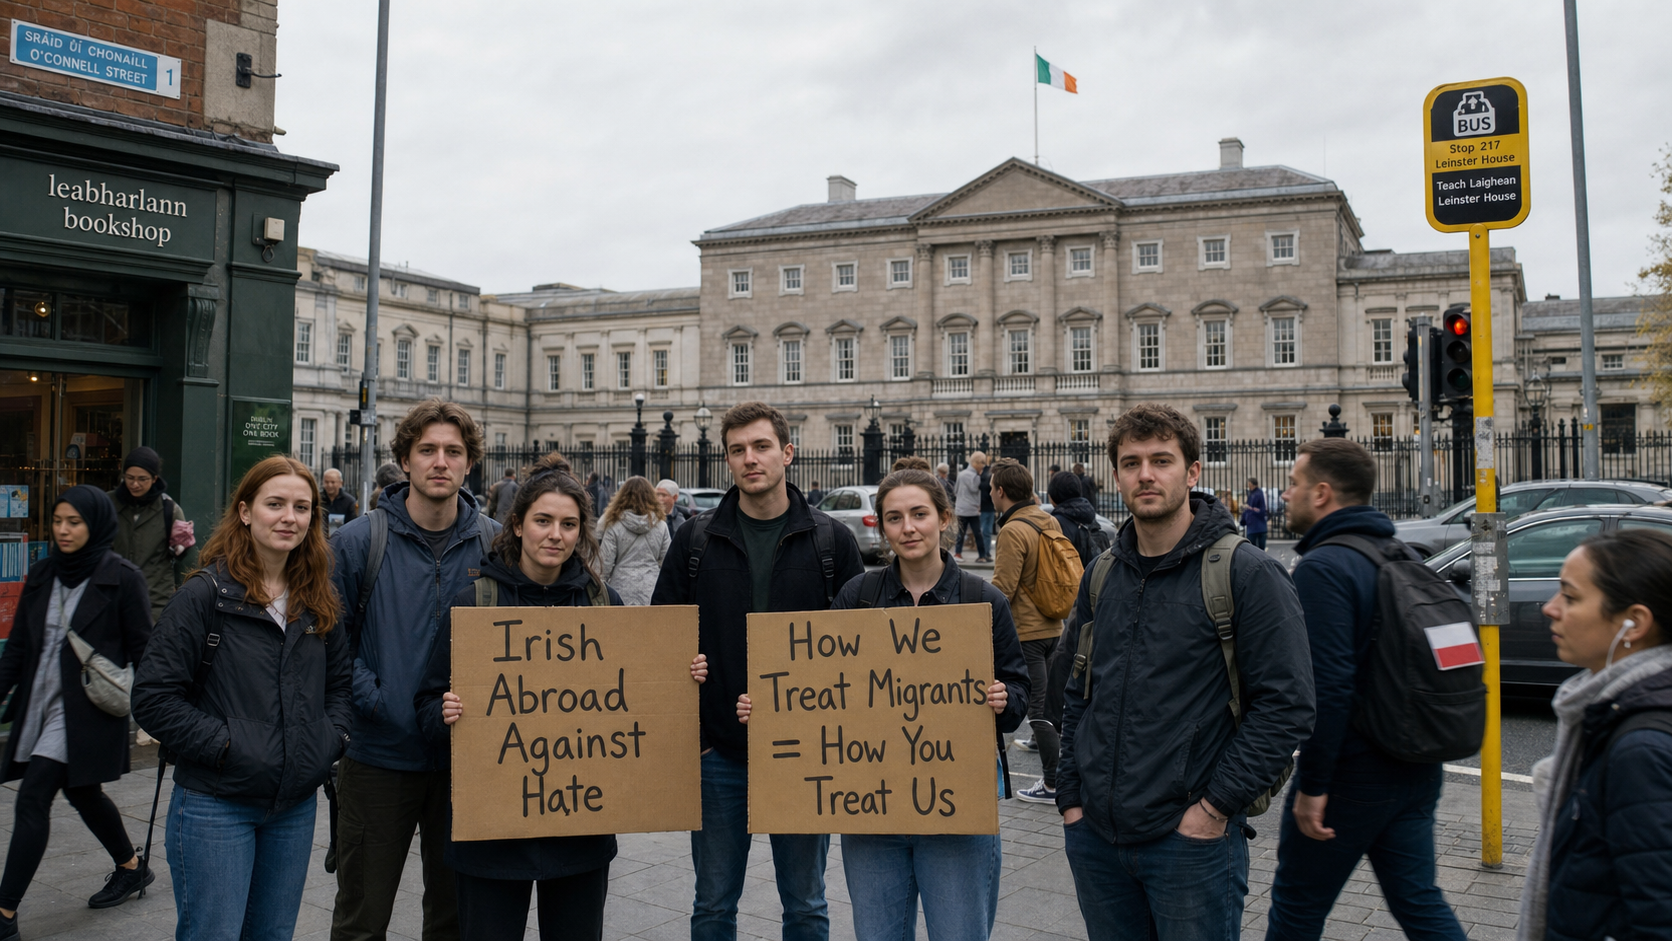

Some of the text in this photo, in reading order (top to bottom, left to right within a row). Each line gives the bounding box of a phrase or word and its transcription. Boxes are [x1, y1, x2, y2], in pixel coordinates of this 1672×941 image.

[30, 48, 148, 85] O'CONNELL STREET
[166, 69, 173, 86] 1
[1458, 117, 1491, 133] BUS
[1436, 153, 1515, 169] Leinster House
[1450, 140, 1500, 154] Stop 217
[48, 174, 188, 218] leabharlann
[1437, 176, 1516, 191] Teach Laighean
[1438, 192, 1516, 206] Leinster House
[63, 207, 172, 247] bookshop
[492, 619, 605, 663] Irish
[789, 617, 943, 661] How We
[486, 668, 629, 717] Abroad
[760, 668, 988, 723] Treat Migrants
[497, 721, 646, 777] Against
[821, 724, 887, 766] How
[902, 724, 956, 766] You
[521, 774, 604, 818] Hate
[804, 775, 957, 818] Treat Us
